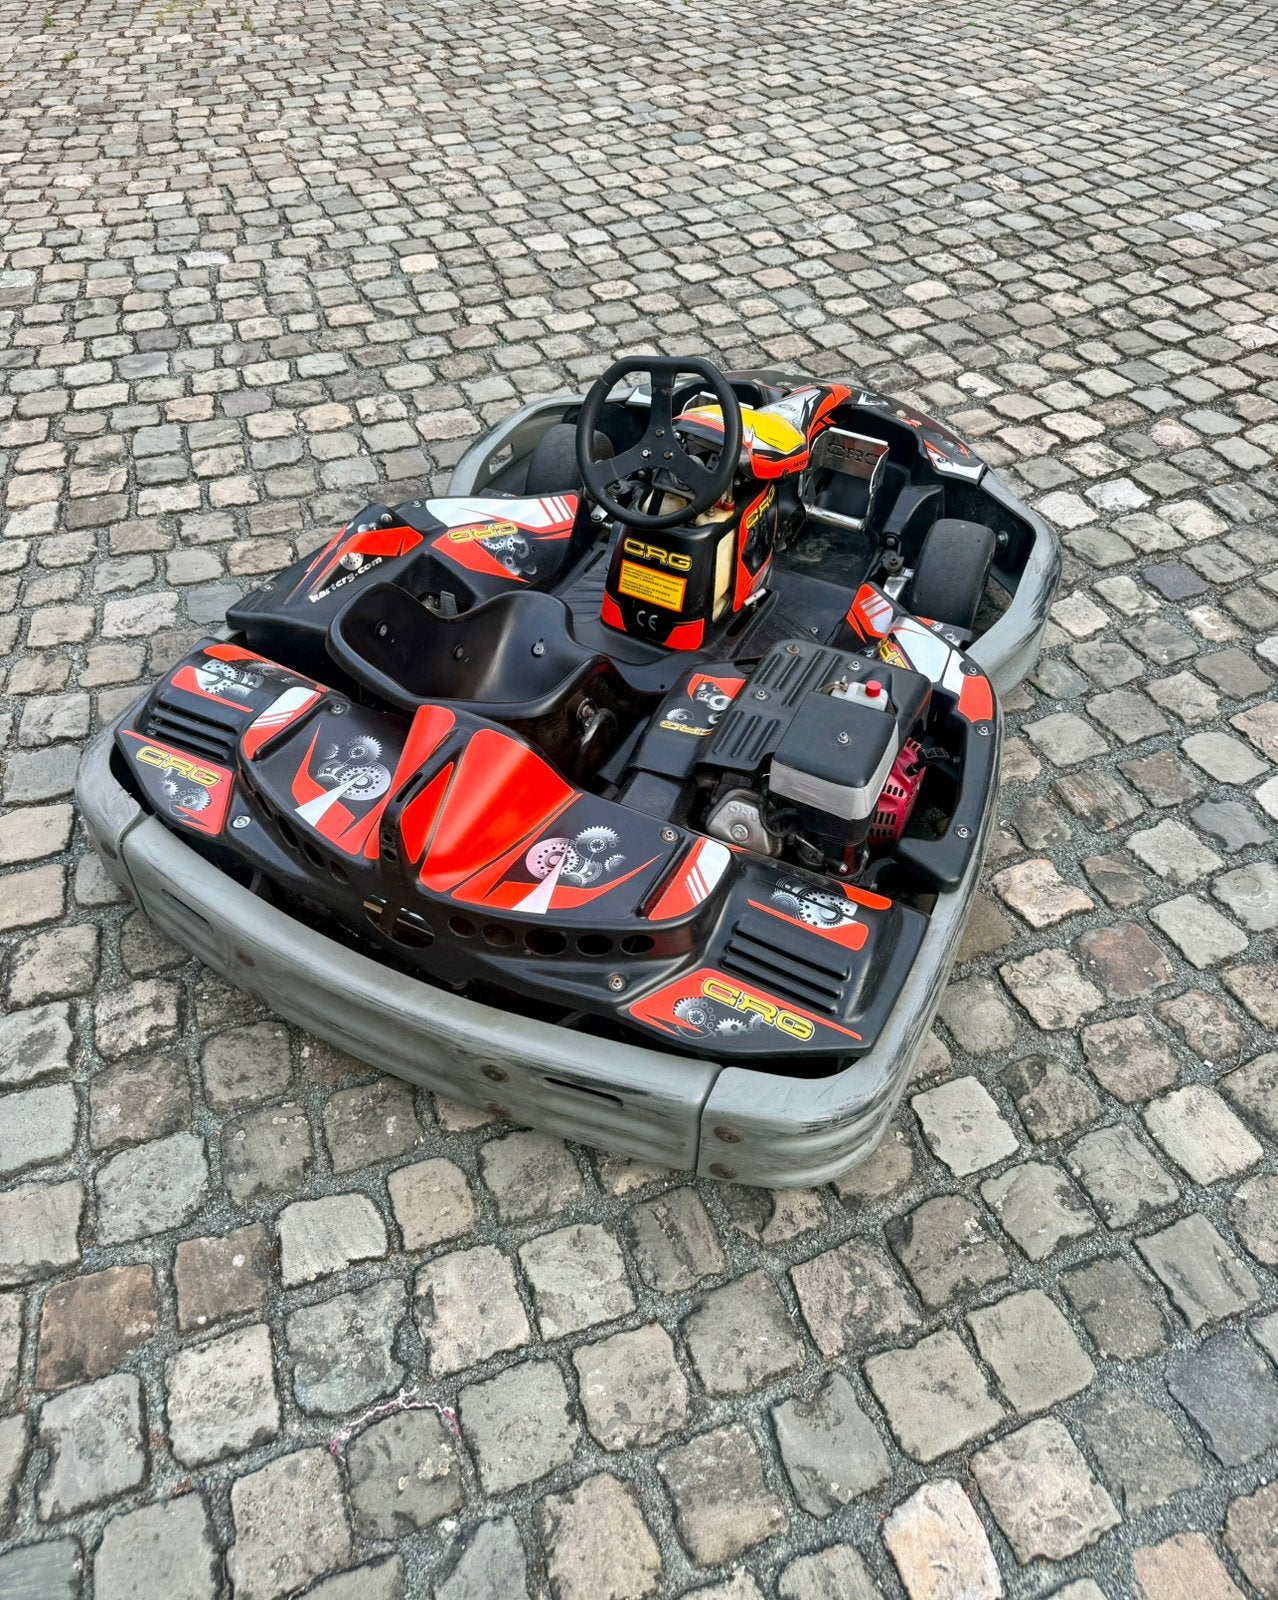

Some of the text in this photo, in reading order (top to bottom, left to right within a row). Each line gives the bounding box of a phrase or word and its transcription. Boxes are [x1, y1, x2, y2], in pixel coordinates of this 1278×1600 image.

[448, 521, 518, 544] CRG
[623, 536, 692, 571] CRG
[309, 556, 383, 603] kartcrg.com
[636, 610, 659, 631] CE
[135, 745, 222, 788] CRG
[702, 978, 815, 1041] CRG
